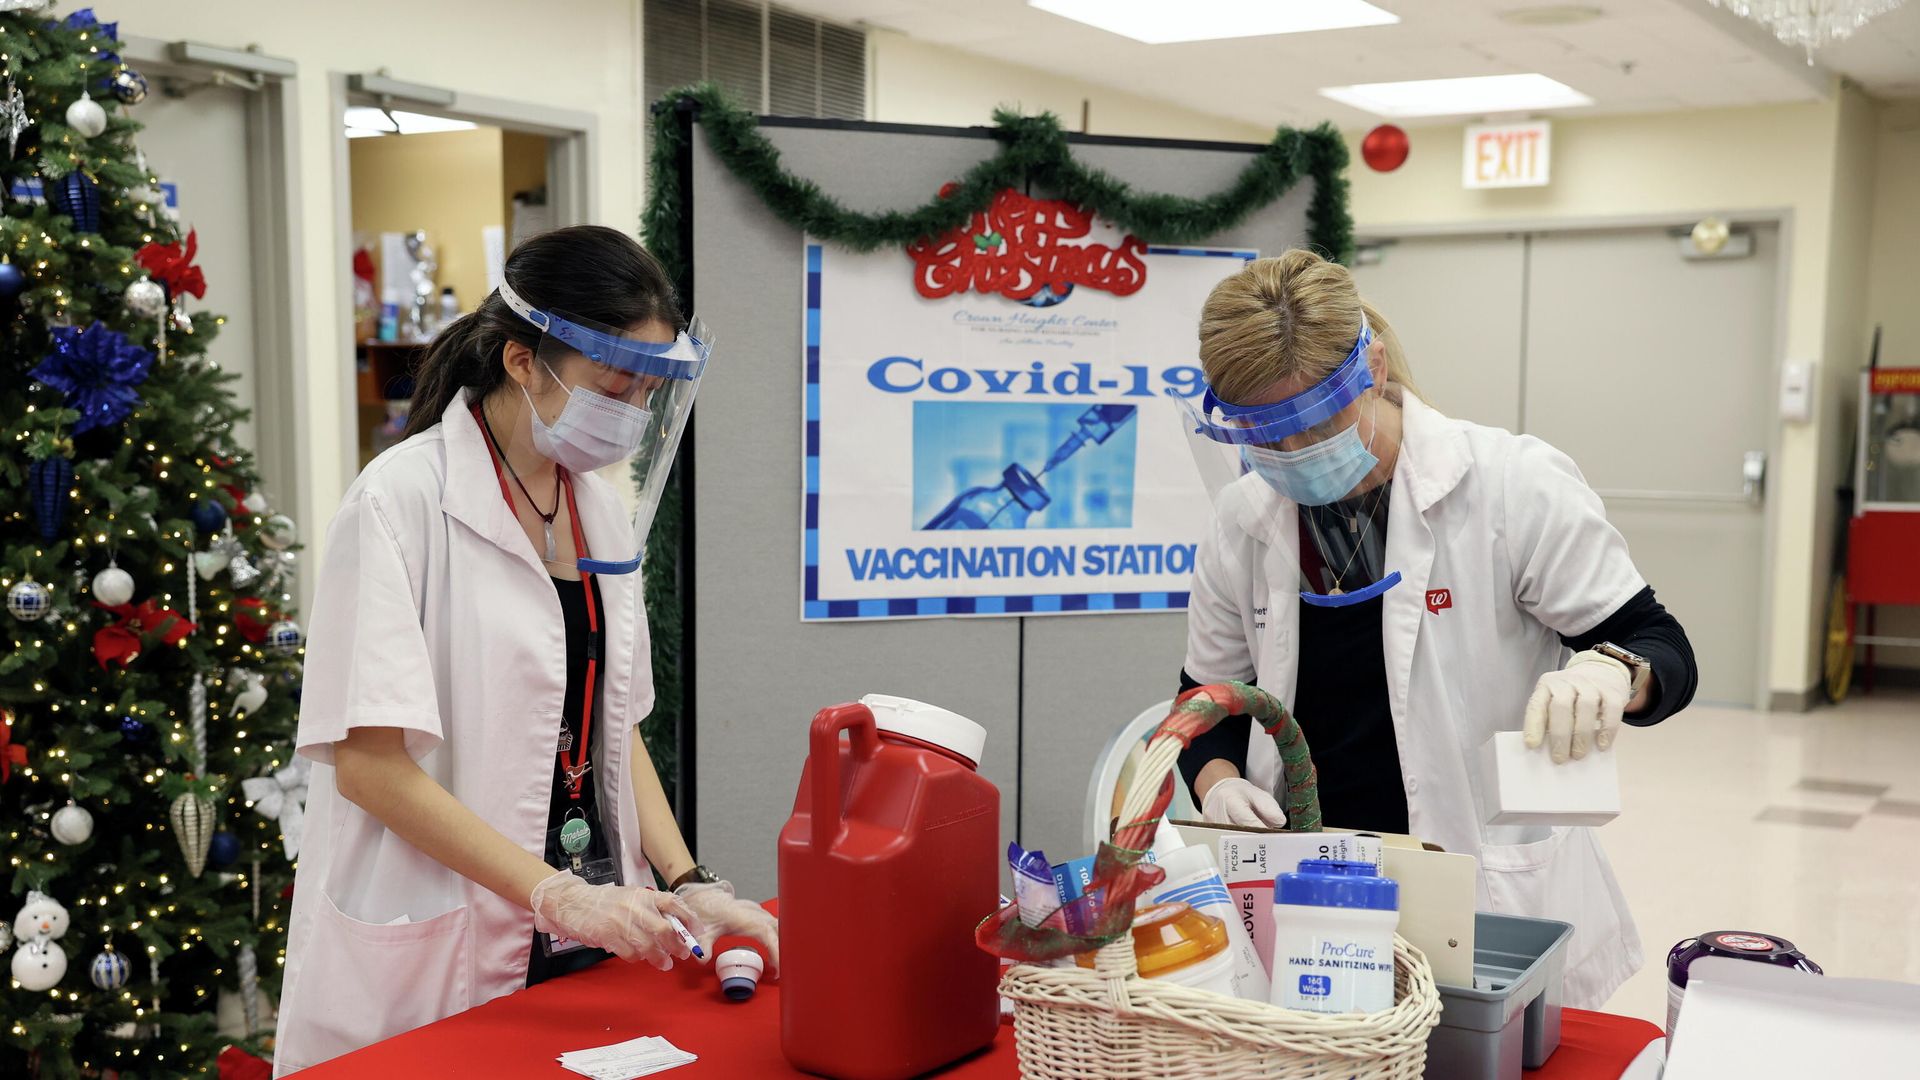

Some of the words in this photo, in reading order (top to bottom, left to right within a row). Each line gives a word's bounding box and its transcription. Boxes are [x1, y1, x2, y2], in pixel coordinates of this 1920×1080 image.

[1476, 130, 1543, 181] EXIT
[908, 233, 1148, 299] Christmas
[952, 310, 1002, 323] Crown
[1004, 312, 1068, 332] Heights
[1070, 314, 1119, 328] Center
[866, 356, 1205, 398] Covid-19
[845, 546, 1077, 581] VACCINATION
[1231, 845, 1239, 872] PC520
[1242, 853, 1256, 864] L
[1259, 844, 1267, 874] LARGE
[1339, 839, 1347, 862] eight
[1080, 866, 1091, 885] 100
[1243, 893, 1254, 944] OVES
[1321, 941, 1375, 958] ProCure
[1288, 957, 1315, 967] HAND
[1318, 959, 1376, 971] SANITIZING
[1302, 985, 1326, 995] Wipes
[1307, 977, 1323, 985] 160
